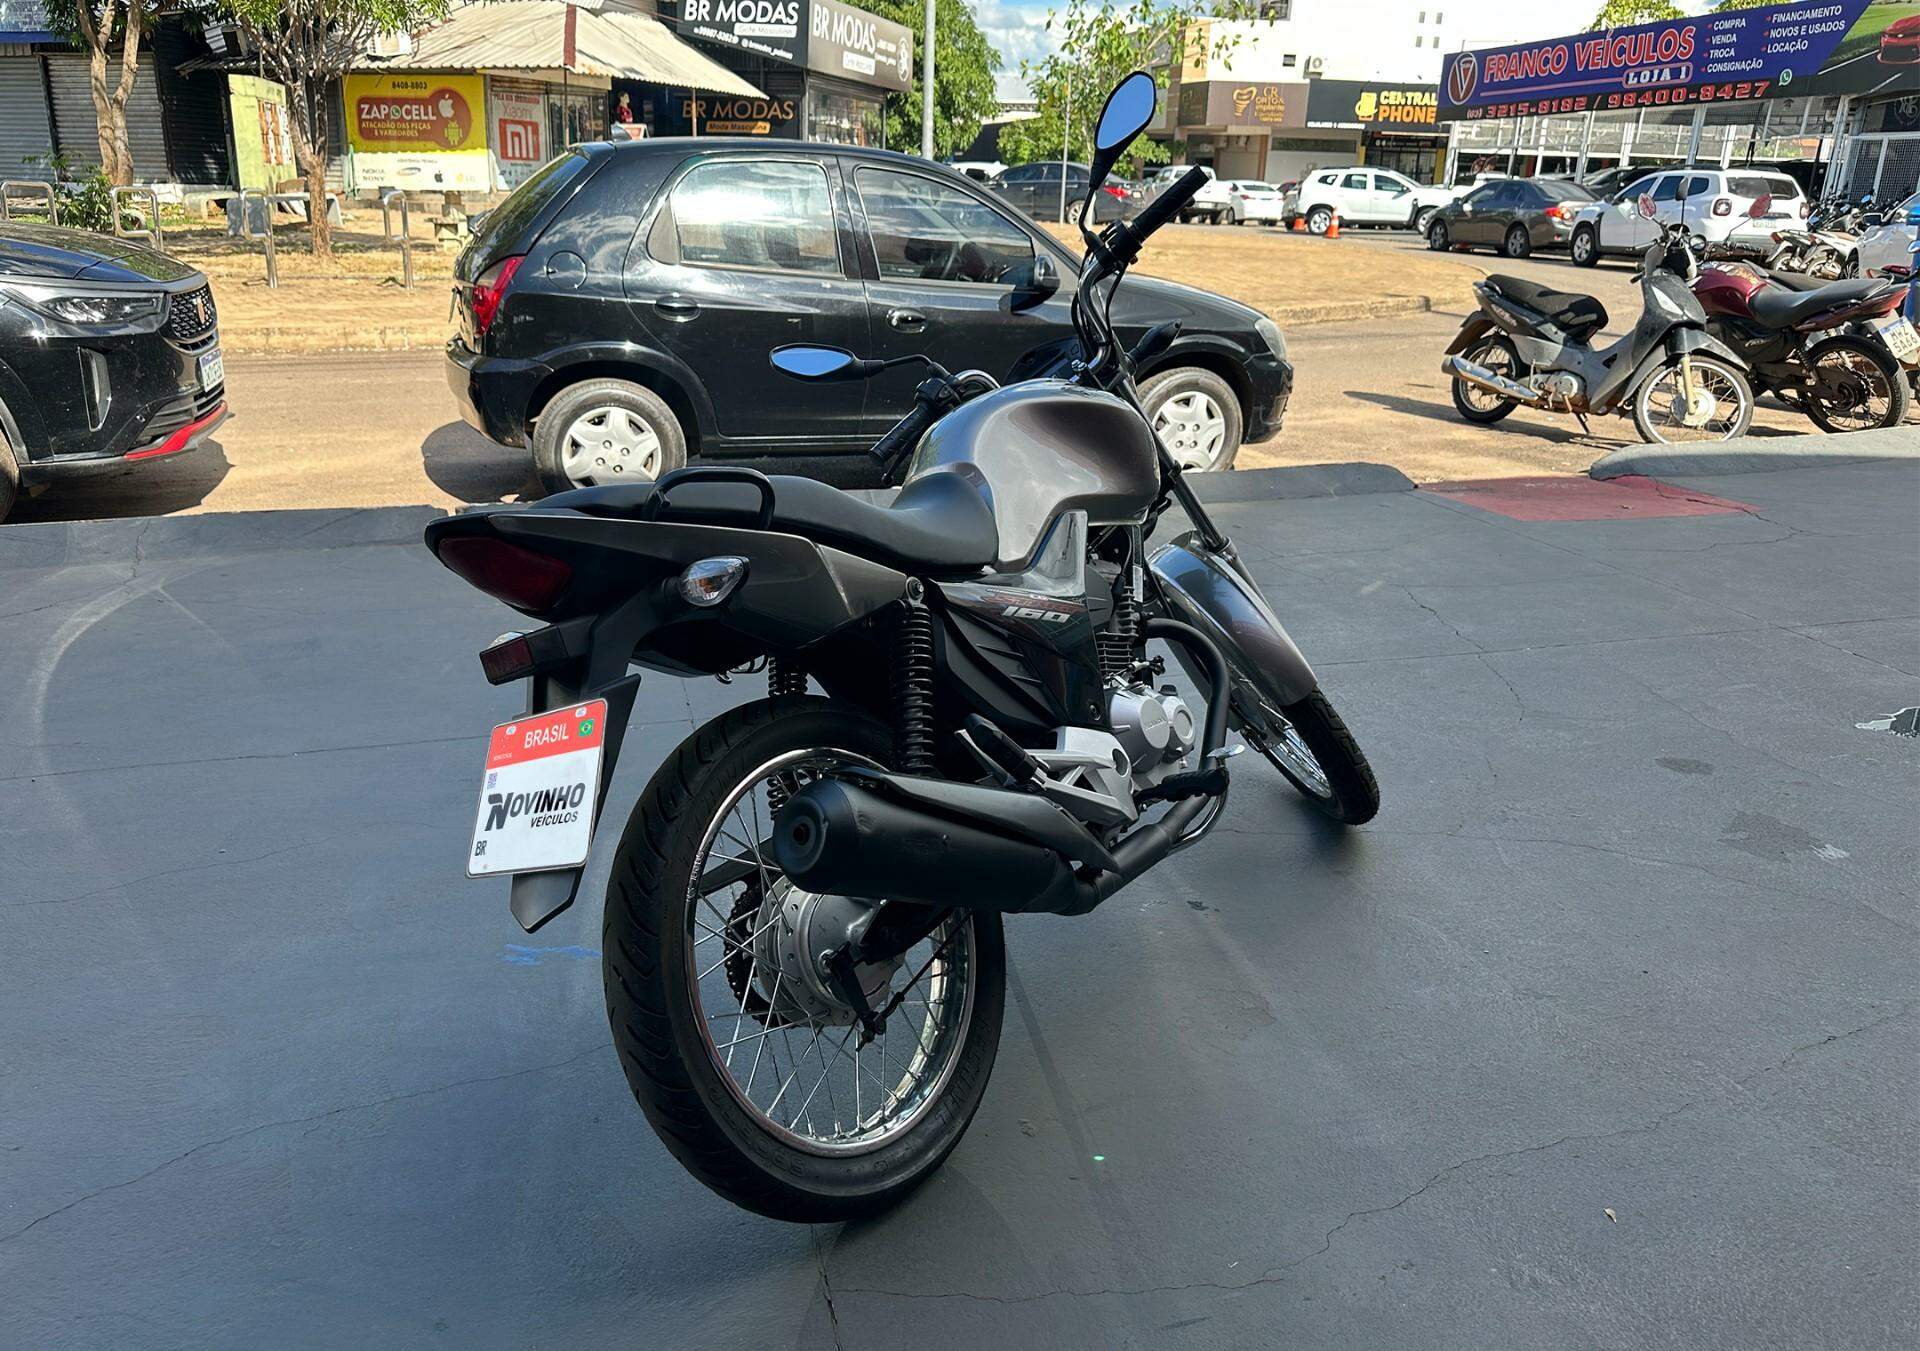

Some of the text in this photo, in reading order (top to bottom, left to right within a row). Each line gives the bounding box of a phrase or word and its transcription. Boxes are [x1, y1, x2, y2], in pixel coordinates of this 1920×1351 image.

[684, 0, 800, 24] BR MODAS
[1772, 5, 1842, 23] FINANCIAMENTO
[813, 3, 876, 54] BR MODAS
[1714, 18, 1746, 30] COMPRA
[1770, 20, 1845, 38] NOVOS E USADOS
[1712, 34, 1737, 45] VENDA
[1767, 39, 1808, 54] LOCAÇÃO
[1483, 26, 1697, 83] FRANCO VEÍCULOS
[1709, 48, 1735, 59] TROCA
[1707, 59, 1763, 73] CONSIGNAÇÃO
[1628, 68, 1671, 84] LOJA
[1380, 91, 1438, 106] CENTRAL
[1485, 97, 1588, 118] 3215-8182
[1608, 81, 1770, 108] 98400-8427
[682, 100, 794, 120] BR MODAS
[1378, 106, 1438, 124] PHONE
[1002, 605, 1071, 623] 160
[524, 723, 569, 749] BRASIL
[484, 782, 586, 832] NOVINHO
[530, 811, 579, 828] VEÍCULOS
[475, 840, 487, 856] BR
